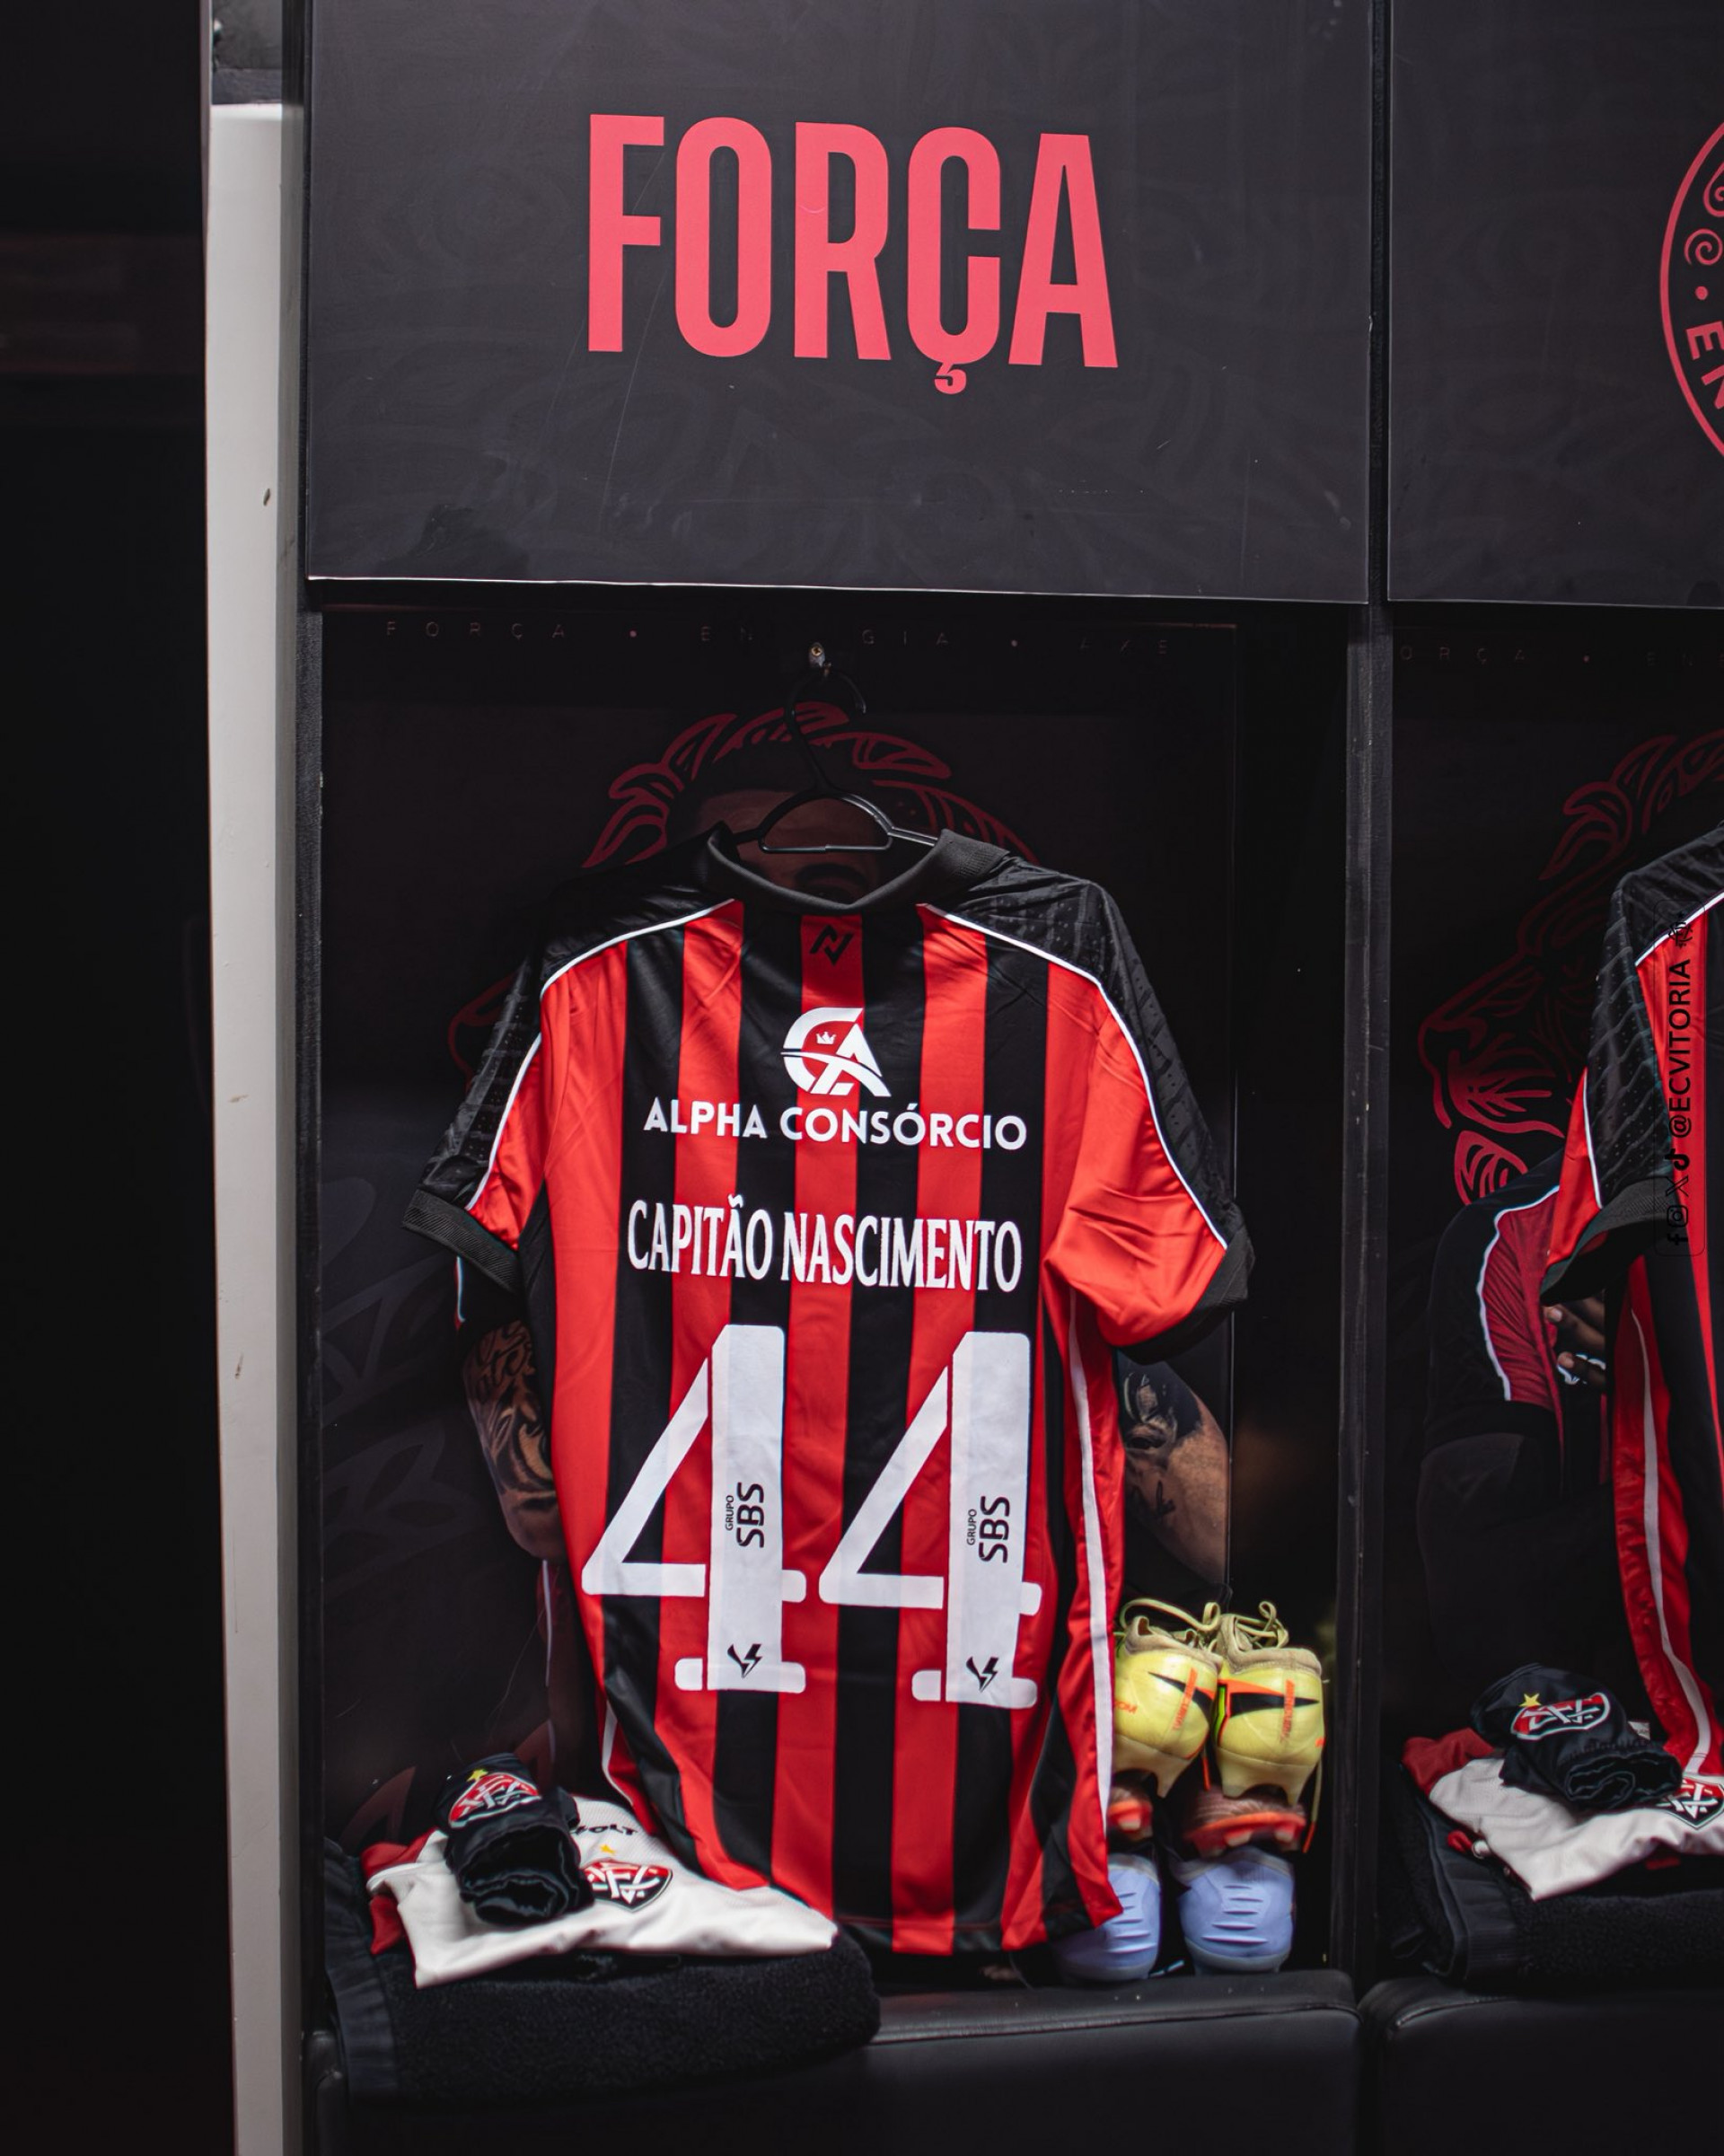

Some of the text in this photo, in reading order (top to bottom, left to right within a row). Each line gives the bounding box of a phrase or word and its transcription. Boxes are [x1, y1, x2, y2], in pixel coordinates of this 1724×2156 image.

[589, 114, 1118, 394] FORÇA
[386, 620, 565, 640] FORÇA
[1399, 645, 1526, 665] ORÇA
[643, 1096, 1027, 1150] ALPHA CONSÓRCIO
[628, 1193, 1022, 1293] CAPITÃO NASCIMENTO
[581, 1324, 1042, 1710] 44
[725, 1494, 734, 1532] GRUPO
[735, 1482, 765, 1549] SBS
[966, 1509, 978, 1546] GRUPO
[978, 1495, 1010, 1563] SBS
